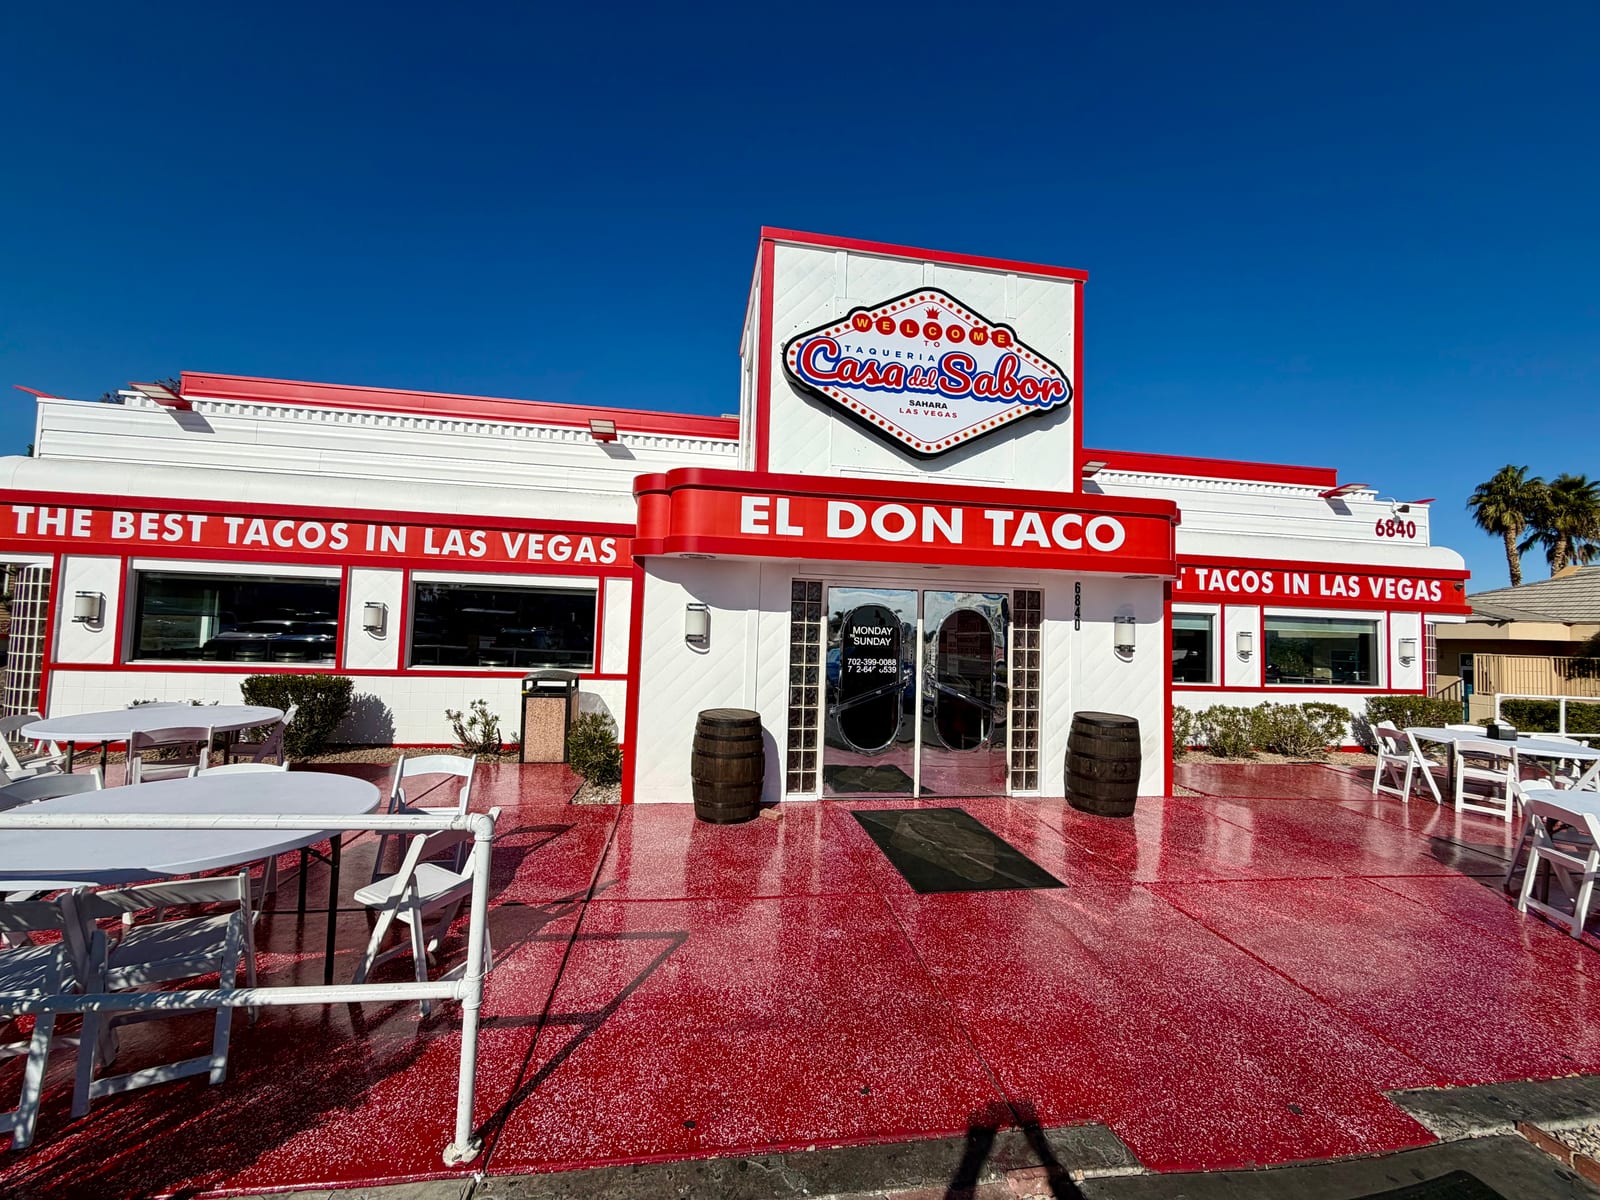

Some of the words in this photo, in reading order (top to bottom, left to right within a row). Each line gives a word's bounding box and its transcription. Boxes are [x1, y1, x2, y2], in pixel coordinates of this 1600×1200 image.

[856, 317, 1006, 345] WELCOME
[844, 344, 936, 362] TAQUERIA
[923, 339, 942, 348] TO
[801, 338, 904, 388] Casa
[907, 366, 939, 389] del
[938, 353, 1064, 402] Sabor
[899, 407, 919, 416] LAS
[923, 409, 959, 419] VEGAS
[909, 399, 948, 410] SAHARA
[740, 495, 804, 537] EL
[826, 500, 963, 544] DON
[984, 509, 1126, 552] TACO
[1375, 518, 1417, 539] 6840
[12, 505, 93, 538] THE
[111, 511, 208, 543] BEST
[223, 516, 349, 550] TACOS
[365, 524, 407, 553] IN
[423, 527, 487, 558] LAS
[501, 532, 617, 564] VEGAS
[1195, 568, 1274, 594] TACOS
[1284, 572, 1310, 595] IN
[1320, 574, 1360, 598] LAS
[1368, 577, 1442, 602] VEGAS
[1073, 581, 1082, 631] 6840
[852, 626, 893, 636] MONDAY
[853, 637, 892, 646] SUNDAY
